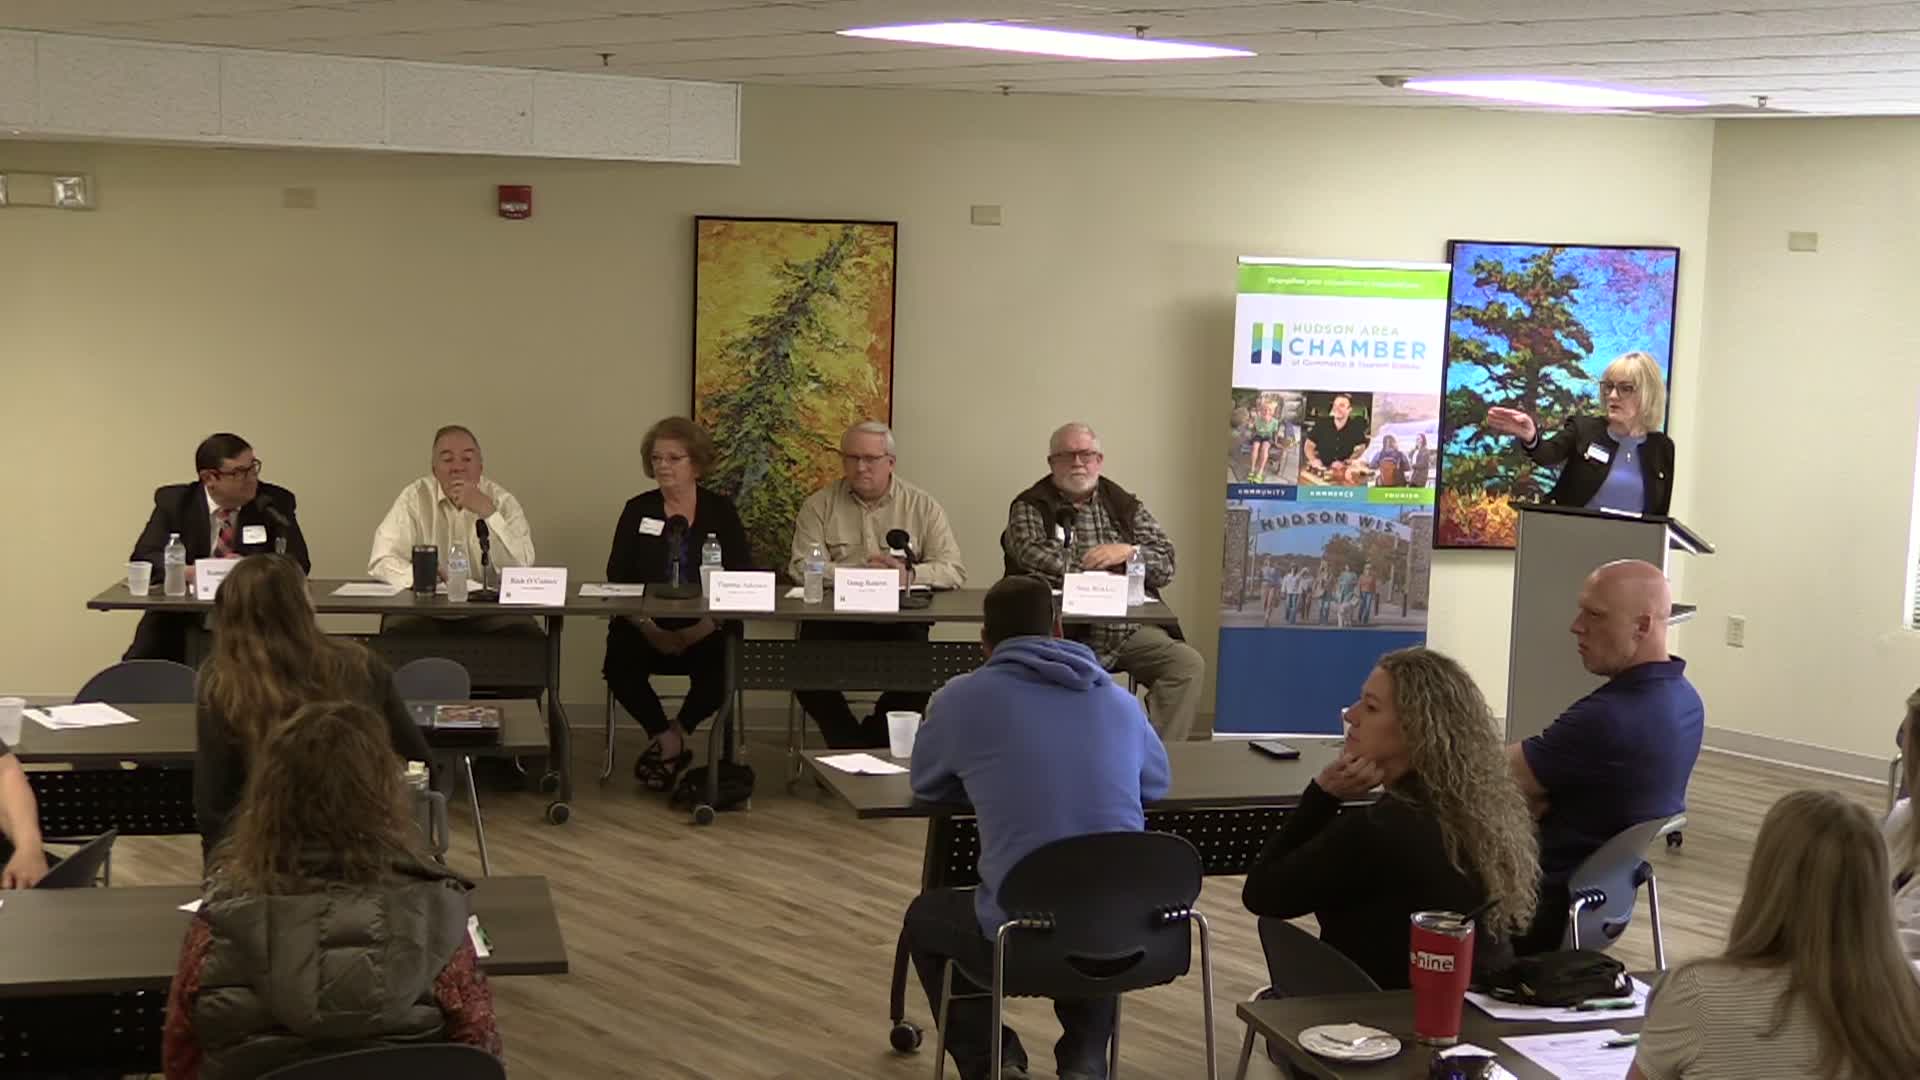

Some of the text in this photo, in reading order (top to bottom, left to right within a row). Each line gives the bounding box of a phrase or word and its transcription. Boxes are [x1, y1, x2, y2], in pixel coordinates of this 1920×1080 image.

[1293, 323, 1399, 336] HUDSON AREA
[1289, 338, 1426, 359] CHAMBER
[1238, 488, 1285, 497] COMMUNITY
[1261, 511, 1349, 532] HUDSON
